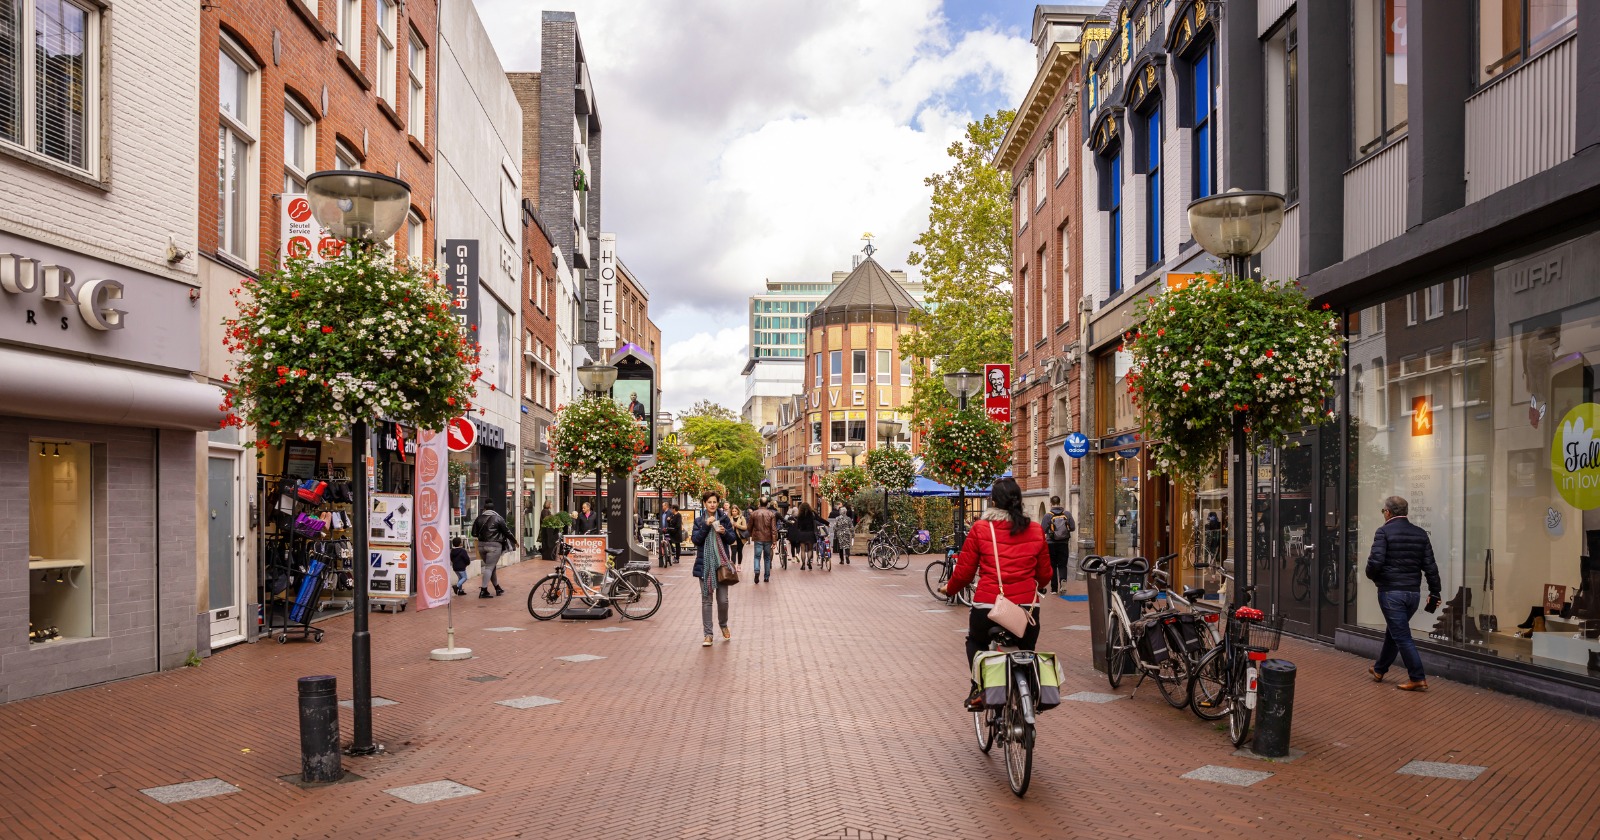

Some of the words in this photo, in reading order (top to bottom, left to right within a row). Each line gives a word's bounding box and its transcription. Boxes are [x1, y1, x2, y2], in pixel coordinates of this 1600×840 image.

[456, 245, 468, 310] G-STAR
[601, 250, 615, 331] HOTEL
[804, 389, 889, 409] UVEL
[988, 407, 1009, 415] KFC
[386, 434, 397, 451] the
[1565, 441, 1600, 472] Fall
[1562, 473, 1575, 489] in
[1577, 471, 1600, 489] lov
[568, 538, 603, 548] Horloge
